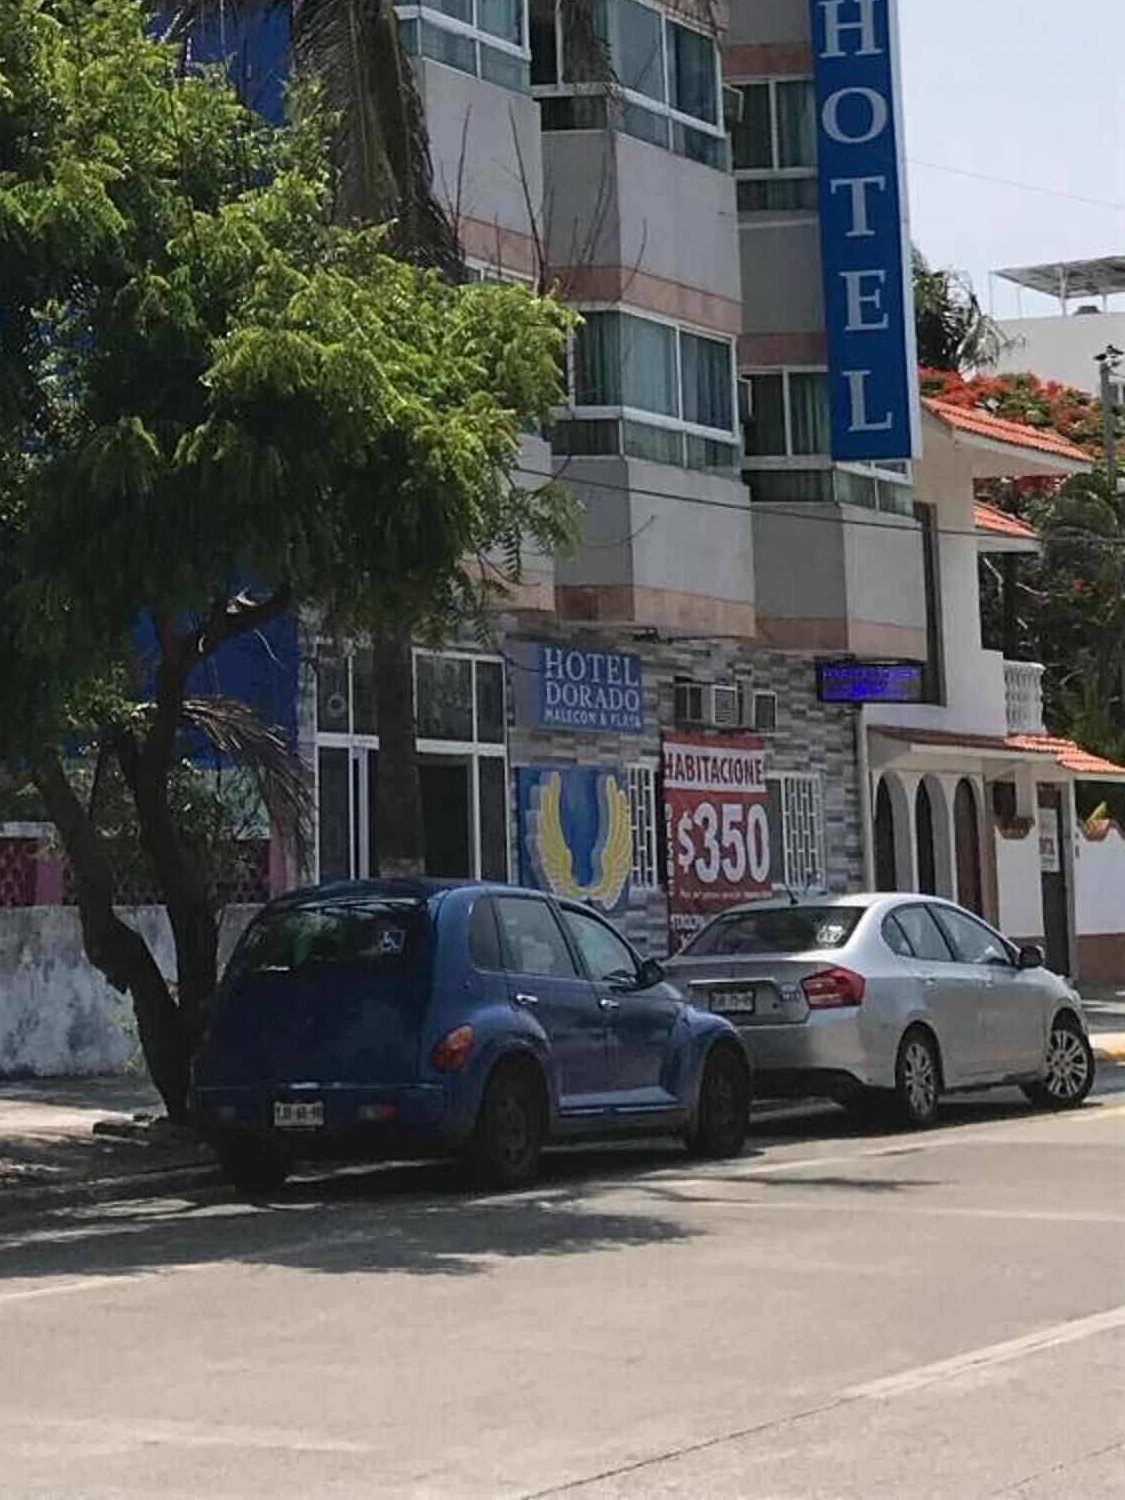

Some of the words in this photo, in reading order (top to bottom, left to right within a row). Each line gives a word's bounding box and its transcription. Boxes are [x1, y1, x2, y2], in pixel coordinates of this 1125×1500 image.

[544, 647, 640, 687] HOTEL
[546, 681, 640, 712] DORADO
[678, 802, 771, 884] $350
